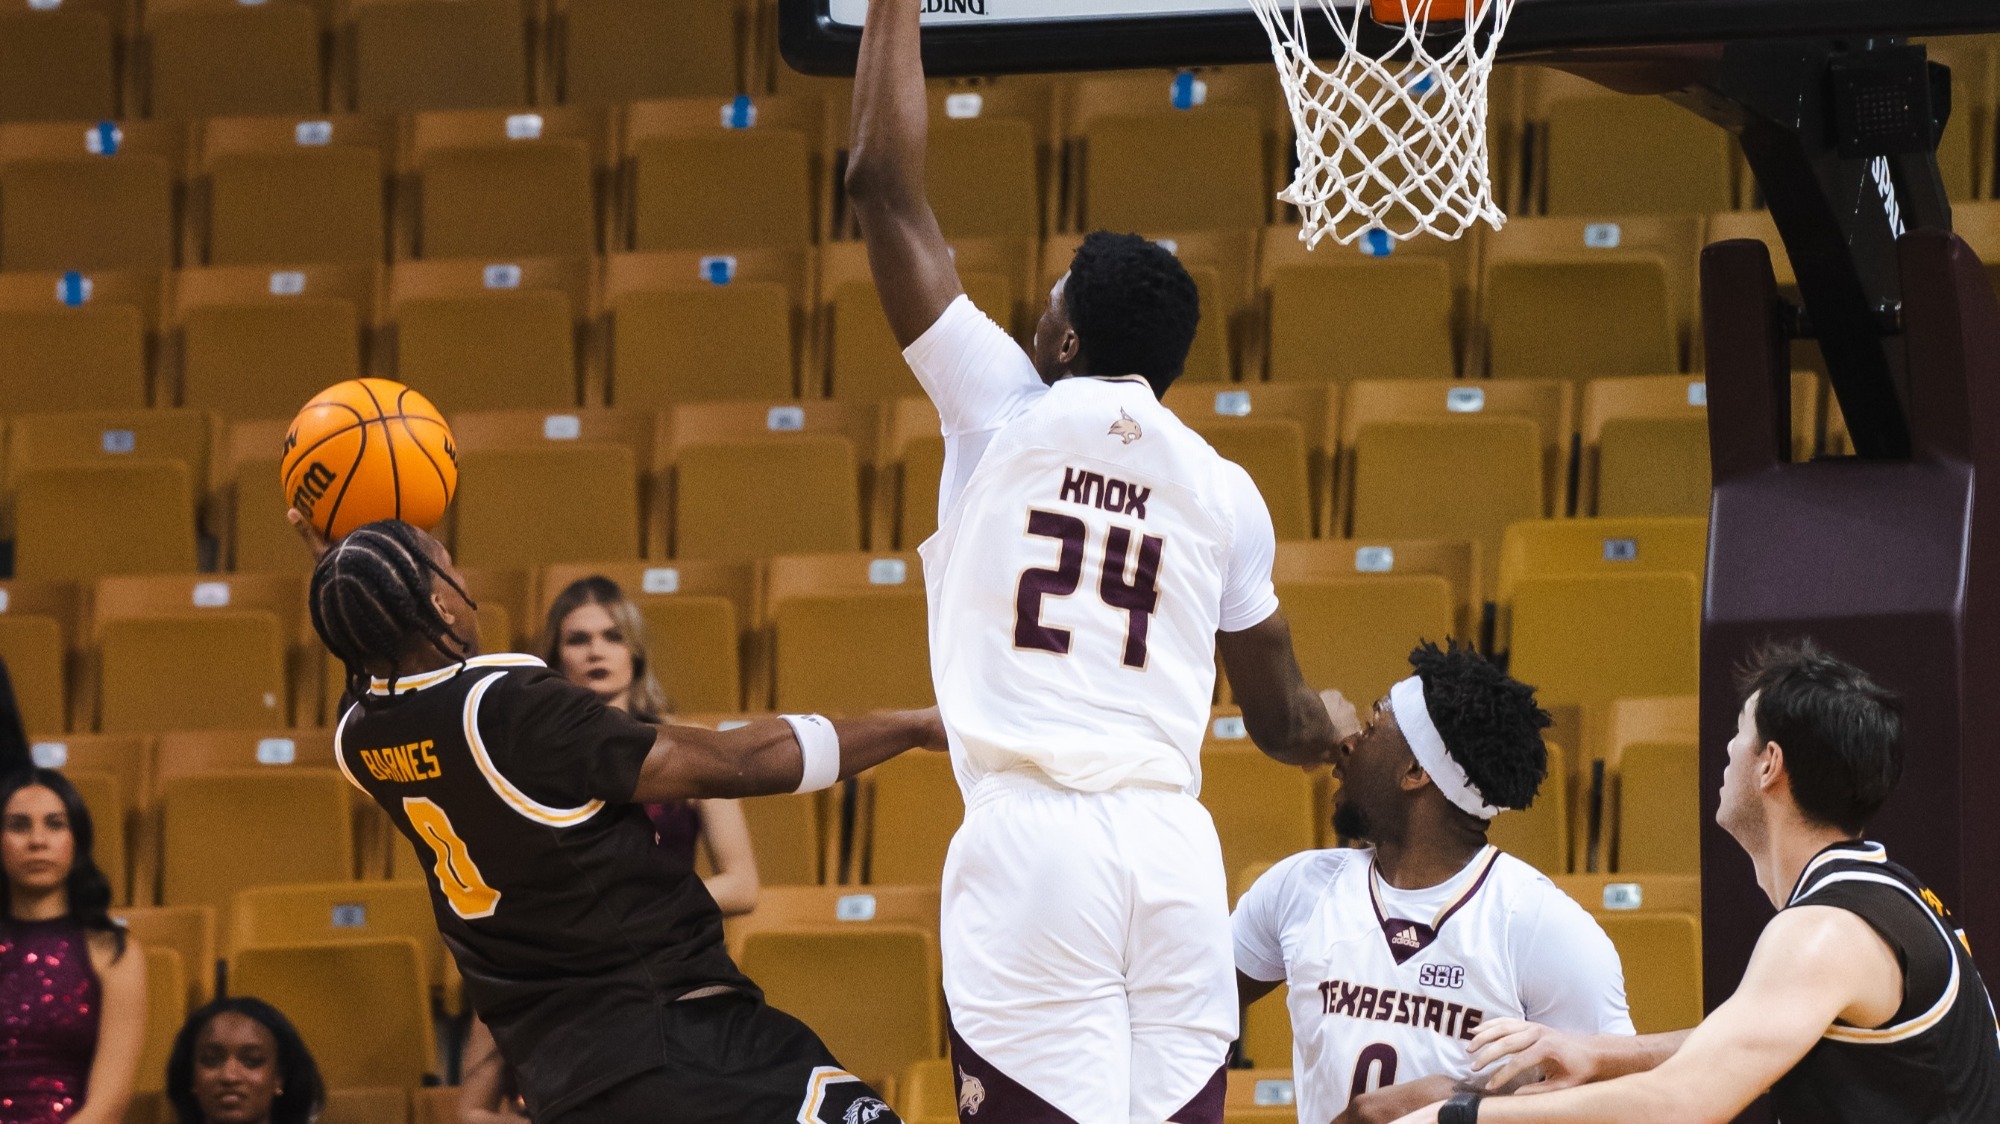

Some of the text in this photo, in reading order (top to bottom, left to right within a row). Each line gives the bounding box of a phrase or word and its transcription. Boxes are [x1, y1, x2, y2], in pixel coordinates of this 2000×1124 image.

[920, 0, 985, 15] DING
[1871, 155, 1906, 241] SPAL
[1059, 465, 1152, 520] KNOX
[1012, 505, 1167, 672] 24
[360, 739, 442, 783] BARNES
[402, 796, 501, 920] 0
[1391, 936, 1420, 949] adidas
[1419, 963, 1464, 989] SBC
